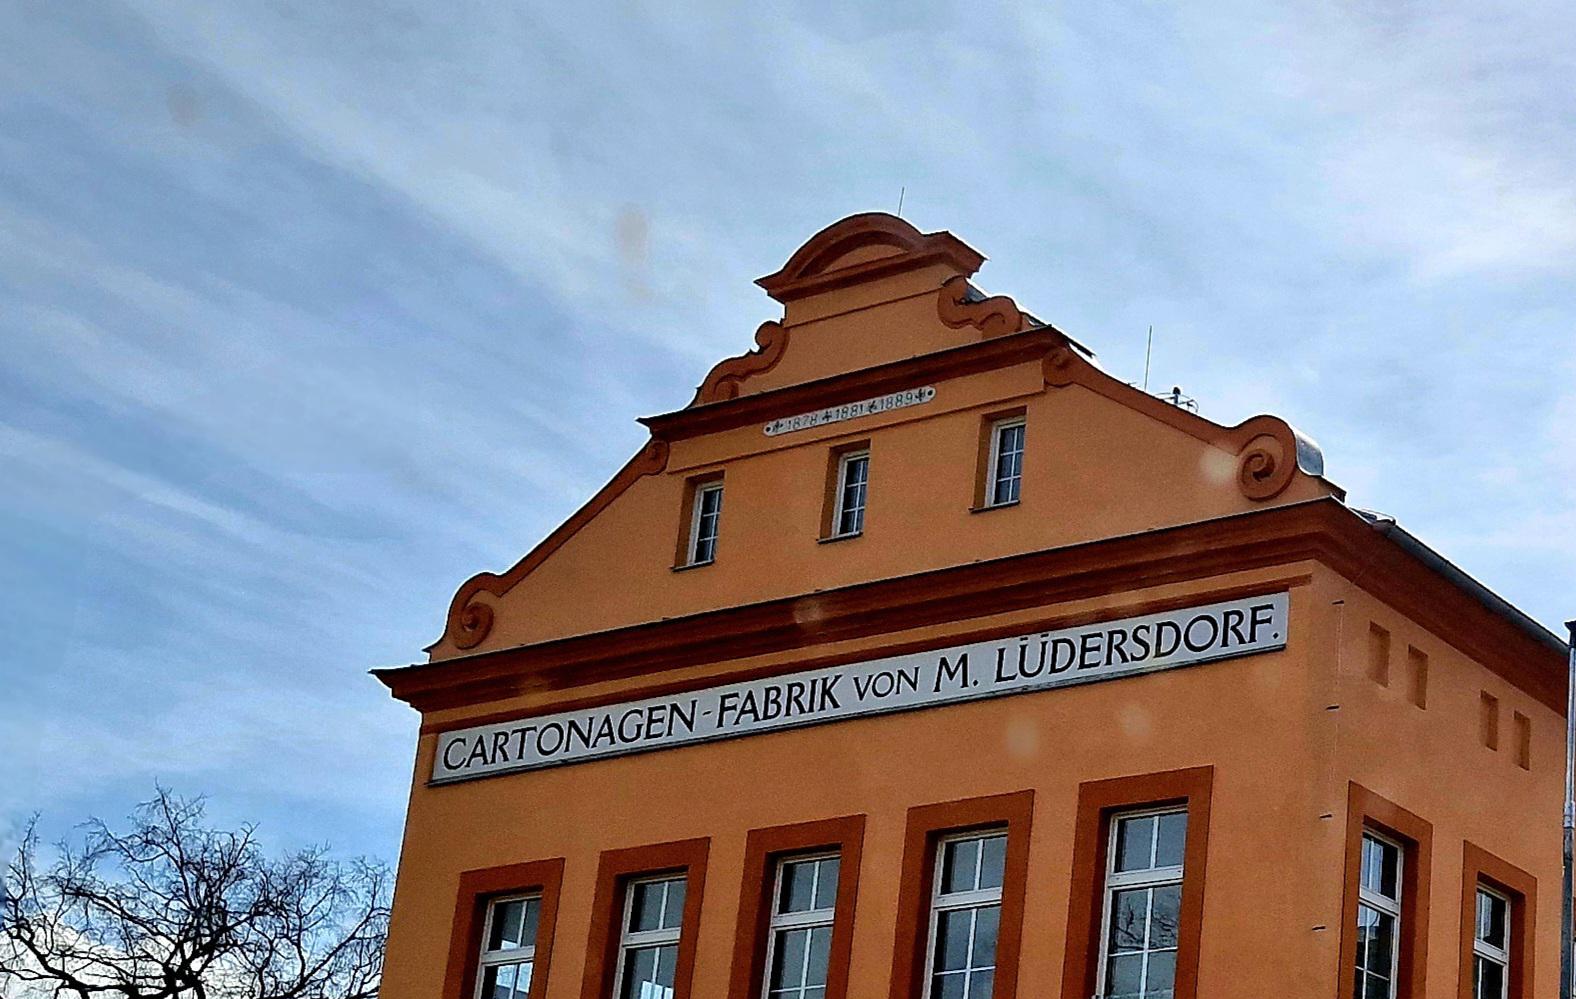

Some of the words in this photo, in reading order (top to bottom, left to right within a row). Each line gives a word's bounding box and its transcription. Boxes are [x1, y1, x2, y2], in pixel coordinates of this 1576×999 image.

[787, 413, 818, 431] 1878
[835, 404, 864, 420] 1881
[880, 391, 914, 410] 1889
[853, 666, 920, 701] VON
[933, 653, 979, 693] M.
[994, 603, 1280, 684] LÜDERSDORF.
